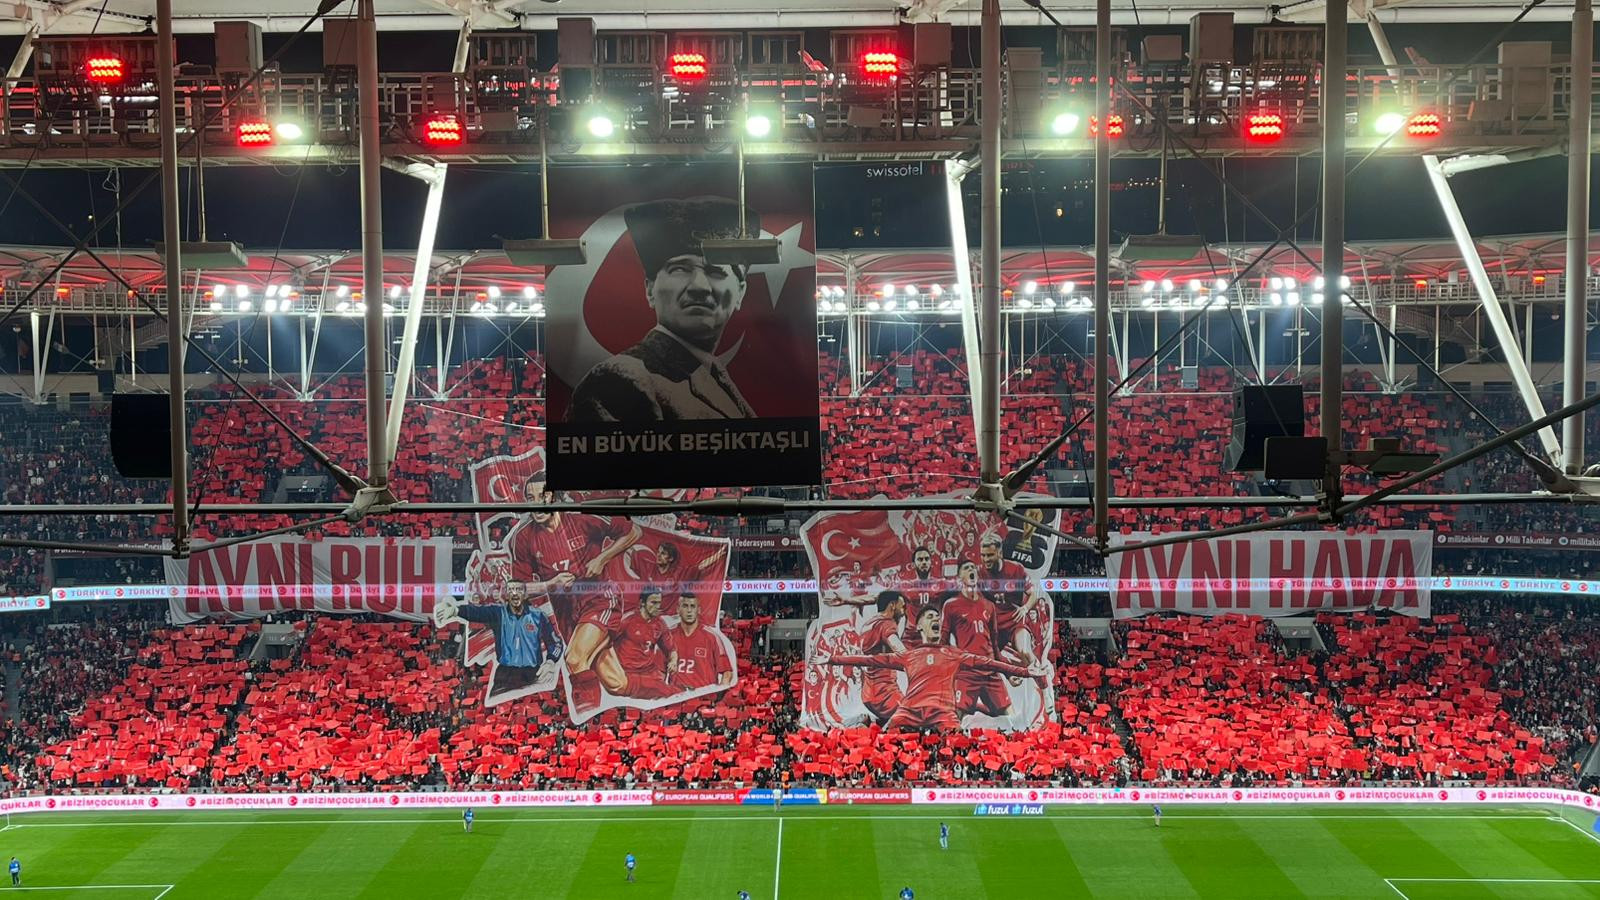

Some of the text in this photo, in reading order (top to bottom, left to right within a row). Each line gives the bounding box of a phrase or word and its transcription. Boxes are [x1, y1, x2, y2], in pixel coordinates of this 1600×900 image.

[557, 428, 810, 454] EN BÜYÜK BEŞİKTAŞLI
[735, 538, 775, 549] Federasyonu
[1011, 551, 1033, 564] FIFA
[186, 543, 436, 614] AYNI RUH
[1116, 539, 1420, 609] AYNI HAVA
[71, 589, 111, 598] TÜRKİYE
[128, 587, 166, 597] TÜRKİYE
[736, 581, 773, 590] TÜRKİYE
[790, 581, 816, 590] TÜRKİ
[1073, 580, 1109, 589] TÜRKİYE
[1456, 579, 1496, 589] TÜRKİYE
[1514, 580, 1555, 591] TÜRKİYE
[918, 592, 930, 604] 10
[973, 620, 985, 633] 18
[678, 658, 695, 674] 22
[60, 798, 145, 808] #BİZİMÇOCUKLAR
[200, 797, 283, 806] #BİZİMÇOCUKLAR
[302, 796, 385, 805] #BİZİMÇOCUKLAR
[404, 795, 487, 804] #BİZİMÇOCUKLAR
[505, 794, 588, 803] #BİZİMÇOCUKLAR
[665, 793, 735, 802] EUROPEAN QUALIFIERS
[840, 792, 909, 801] EUROPEAN QUALIFIERS
[940, 791, 1023, 801] #BİZİMÇOCUKLAR
[1246, 791, 1331, 801] #BİZİMÇOCUKLAR
[1350, 791, 1434, 801] #BİZİMÇOCUKLAR
[1491, 791, 1580, 803] #BİZİMÇOCUKLAR
[988, 804, 1044, 815] fuzul fuzul
